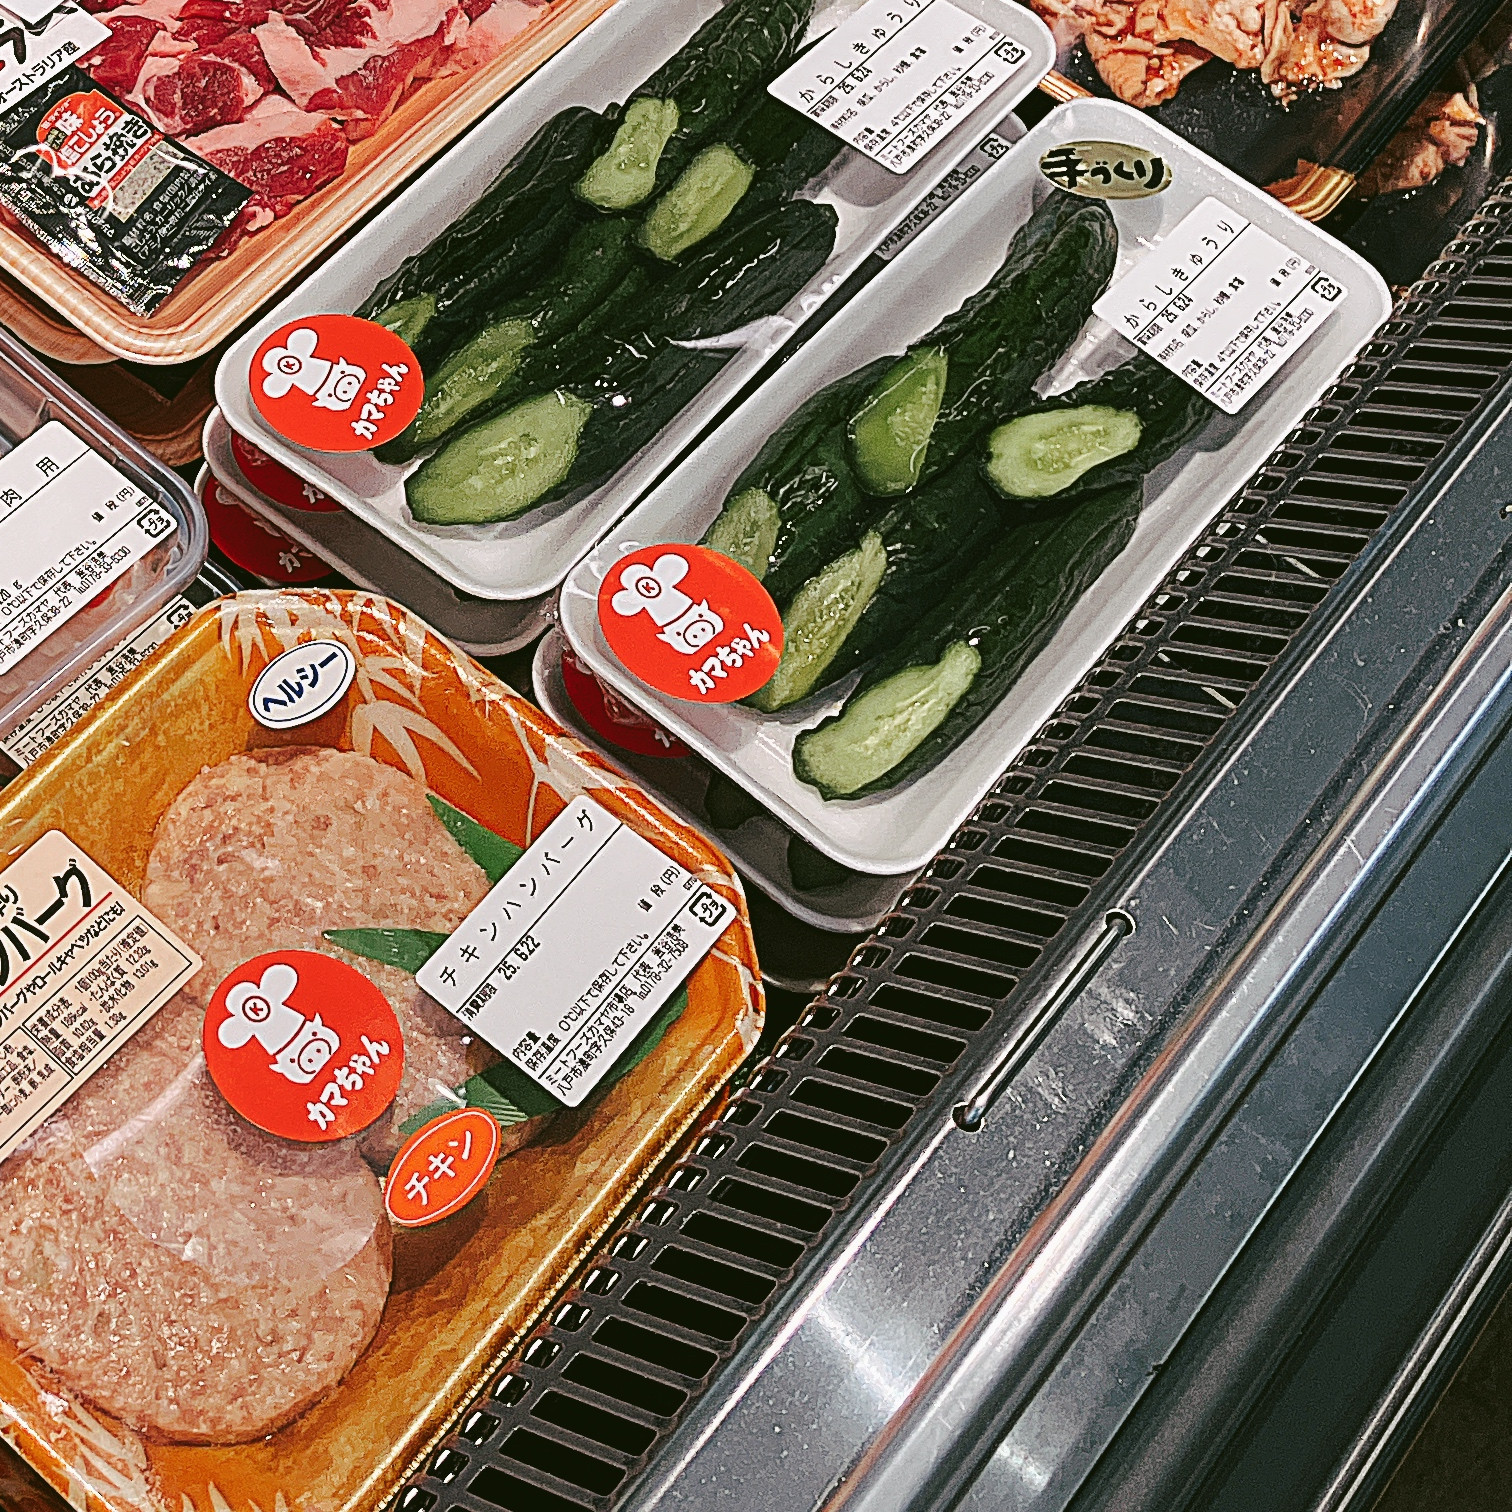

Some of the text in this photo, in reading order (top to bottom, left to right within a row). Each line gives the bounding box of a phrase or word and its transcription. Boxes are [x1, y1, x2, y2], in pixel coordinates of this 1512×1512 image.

[1040, 148, 1165, 190] 手づくり
[1124, 218, 1236, 329] からしきゅうり
[350, 360, 411, 441] カマちゃん
[262, 651, 340, 711] ヘルシー
[688, 622, 771, 695] カマちゃん
[439, 808, 594, 987] チキンハンバーグ
[307, 1034, 391, 1131] カマちゃん
[404, 1130, 472, 1205] チキン
